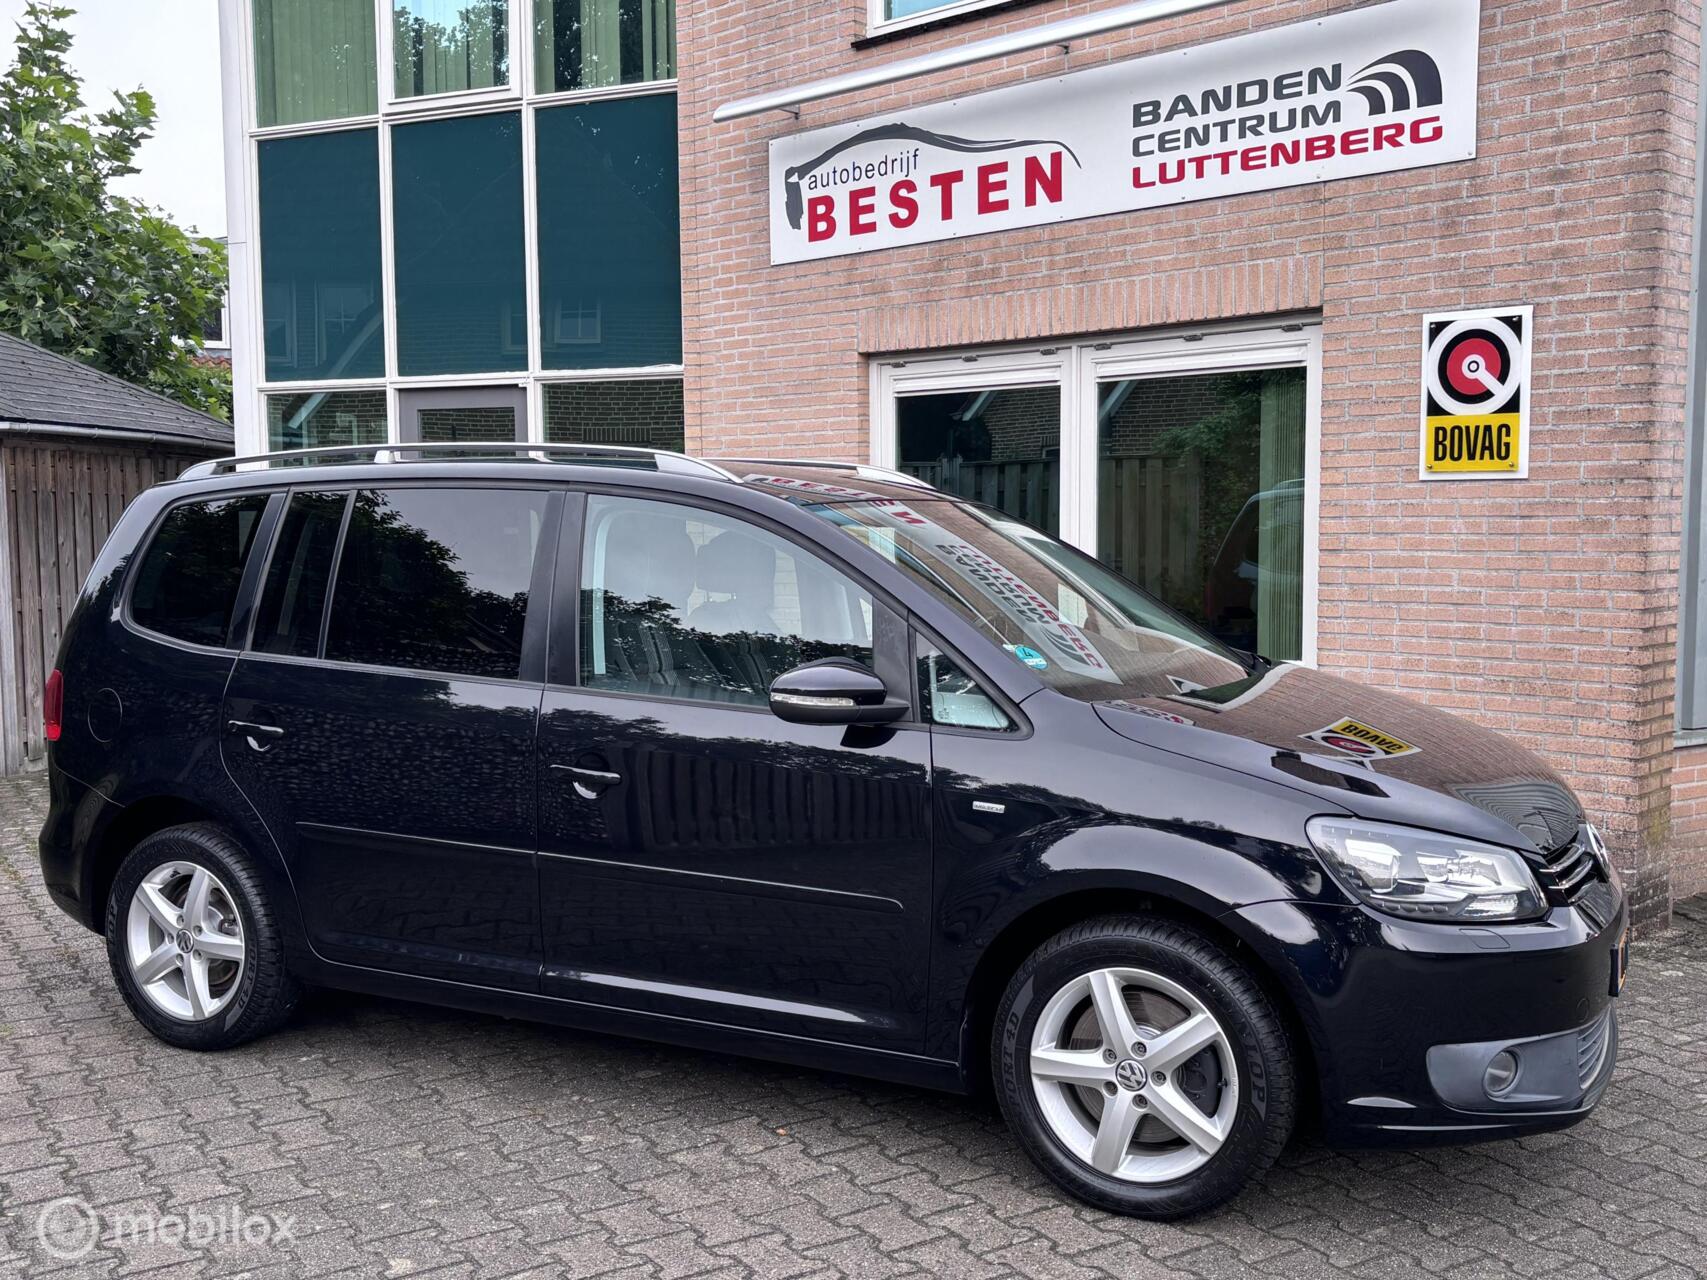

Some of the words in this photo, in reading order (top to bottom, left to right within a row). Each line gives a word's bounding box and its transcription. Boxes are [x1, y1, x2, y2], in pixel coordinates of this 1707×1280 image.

[1132, 63, 1342, 129] BANDEN
[1132, 101, 1341, 157] CENTRUM
[1132, 117, 1443, 188] LUTTENBERG
[807, 148, 919, 190] autobedrijf
[808, 151, 1063, 242] BESTEN
[1434, 423, 1511, 462] BOVAG
[1003, 1046, 1019, 1107] PORT
[1245, 1044, 1266, 1103] LOP
